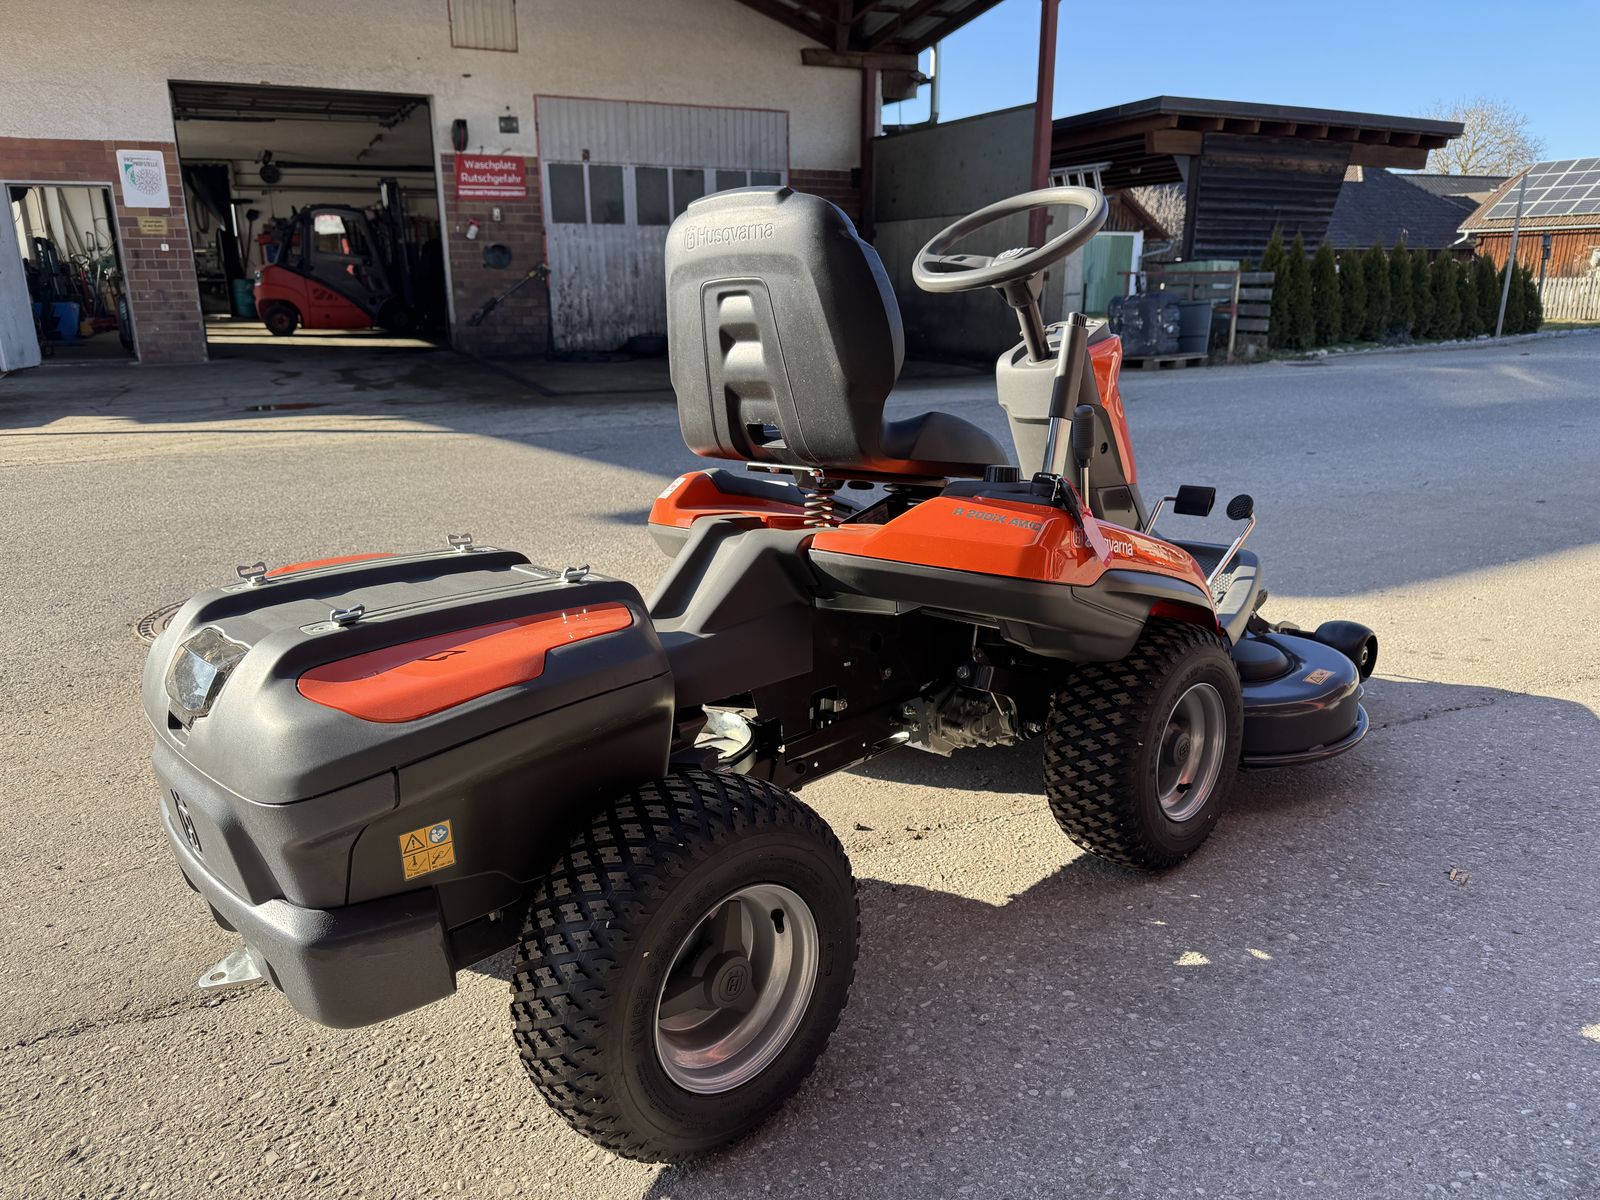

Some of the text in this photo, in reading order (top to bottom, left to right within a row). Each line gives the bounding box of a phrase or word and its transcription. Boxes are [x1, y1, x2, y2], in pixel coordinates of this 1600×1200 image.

[464, 160, 516, 171] Waschplatz
[461, 172, 521, 185] Rutschgefahr
[697, 223, 775, 246] Husqvarna
[1008, 518, 1043, 532] AWD
